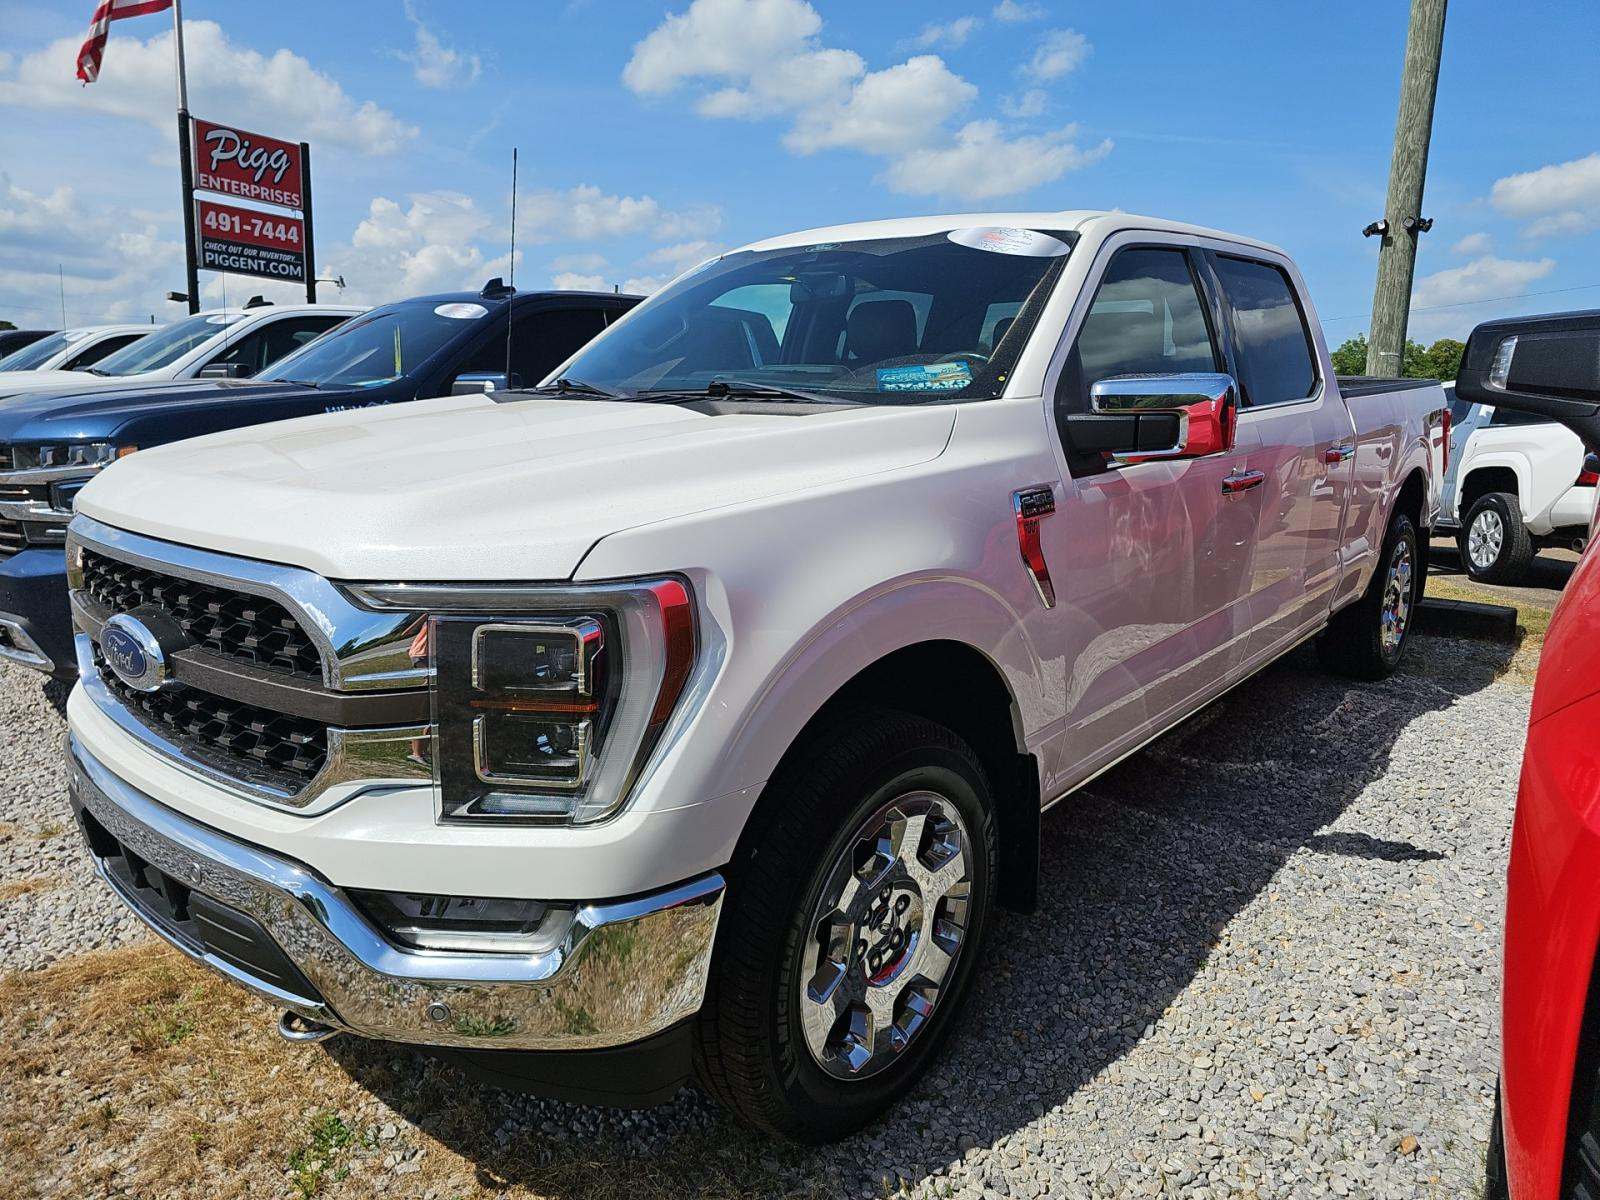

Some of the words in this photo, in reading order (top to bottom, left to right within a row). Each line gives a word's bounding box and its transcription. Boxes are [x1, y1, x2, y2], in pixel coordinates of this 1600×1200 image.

[206, 129, 290, 183] Pigg
[200, 173, 300, 206] ENTERPRISES
[205, 211, 299, 243] 491-7444
[204, 241, 226, 251] CHECK
[228, 245, 242, 254] OUT
[243, 248, 258, 256] OUR
[205, 252, 302, 277] PIGGENT.COM
[107, 634, 134, 672] Ford
[777, 928, 798, 1044] MICHELIN
